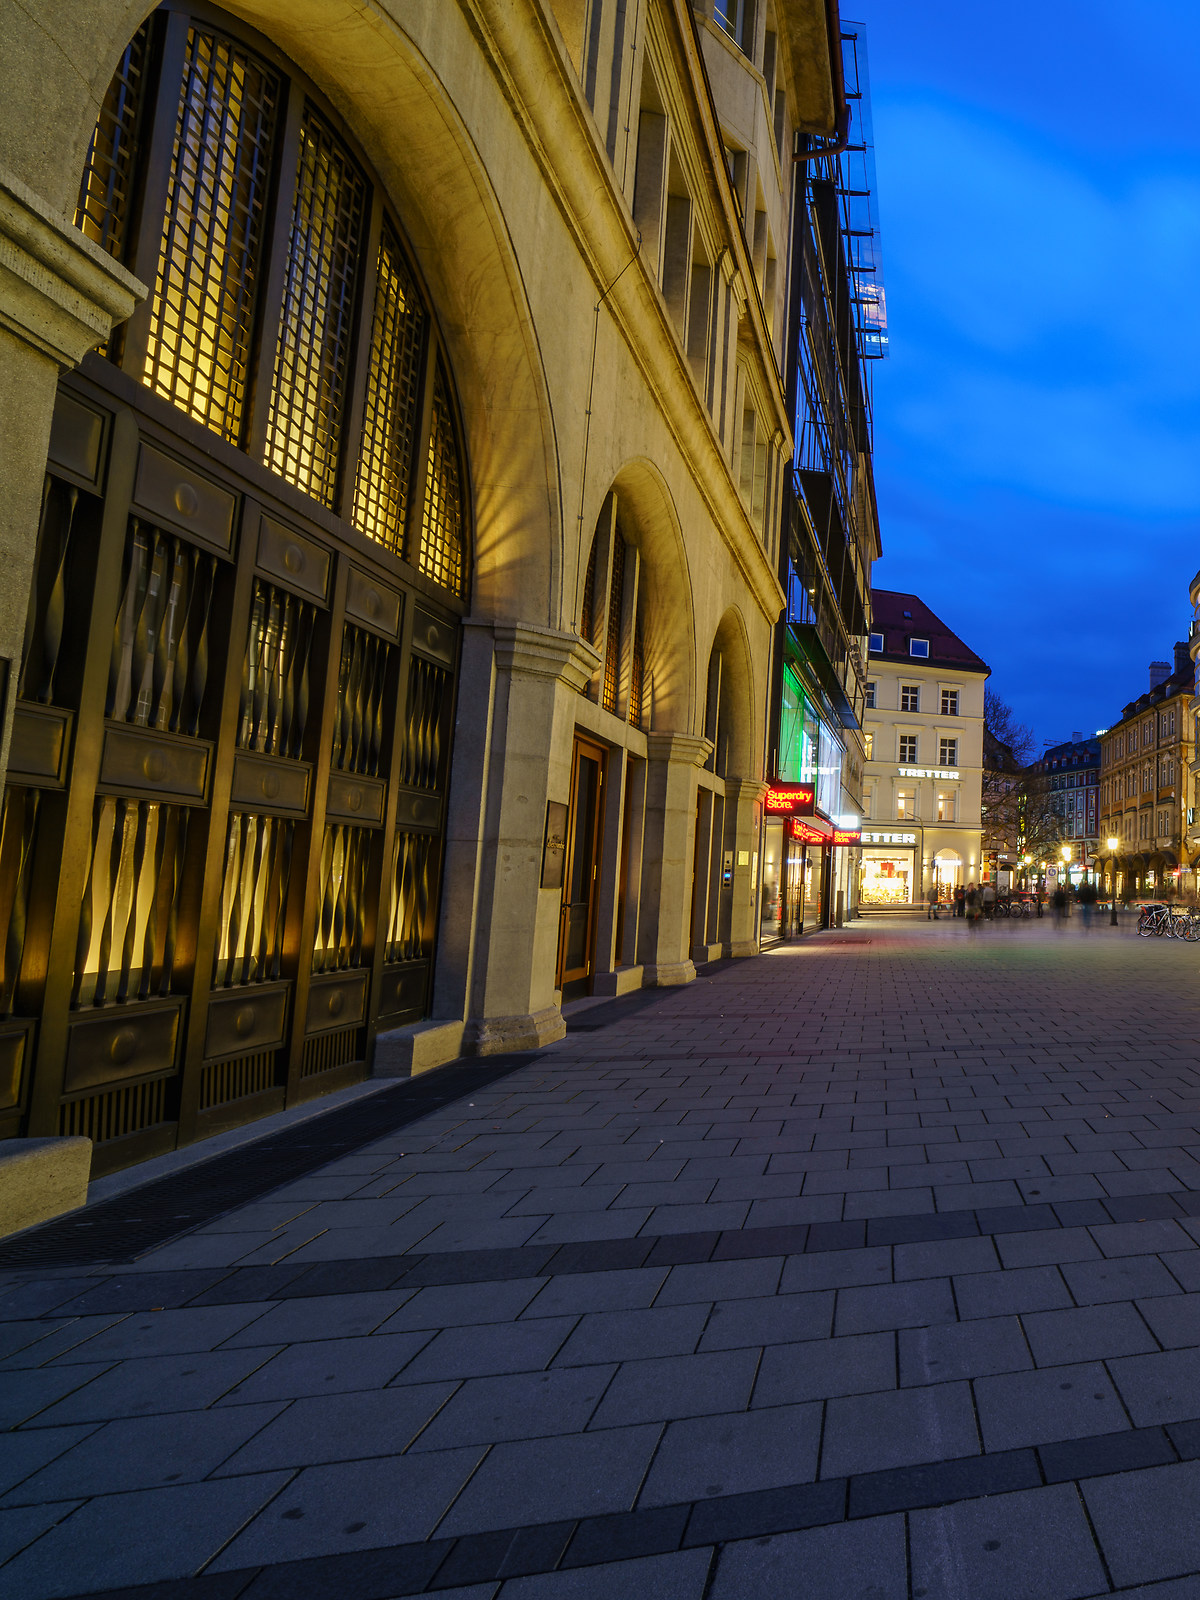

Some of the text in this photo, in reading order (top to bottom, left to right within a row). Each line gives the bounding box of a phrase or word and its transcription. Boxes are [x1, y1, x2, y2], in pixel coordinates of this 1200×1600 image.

[897, 768, 960, 779] TRETTER
[767, 790, 812, 802] Superdry
[767, 799, 793, 809] Store.
[834, 831, 861, 839] Superdry
[860, 833, 916, 843] ETTER
